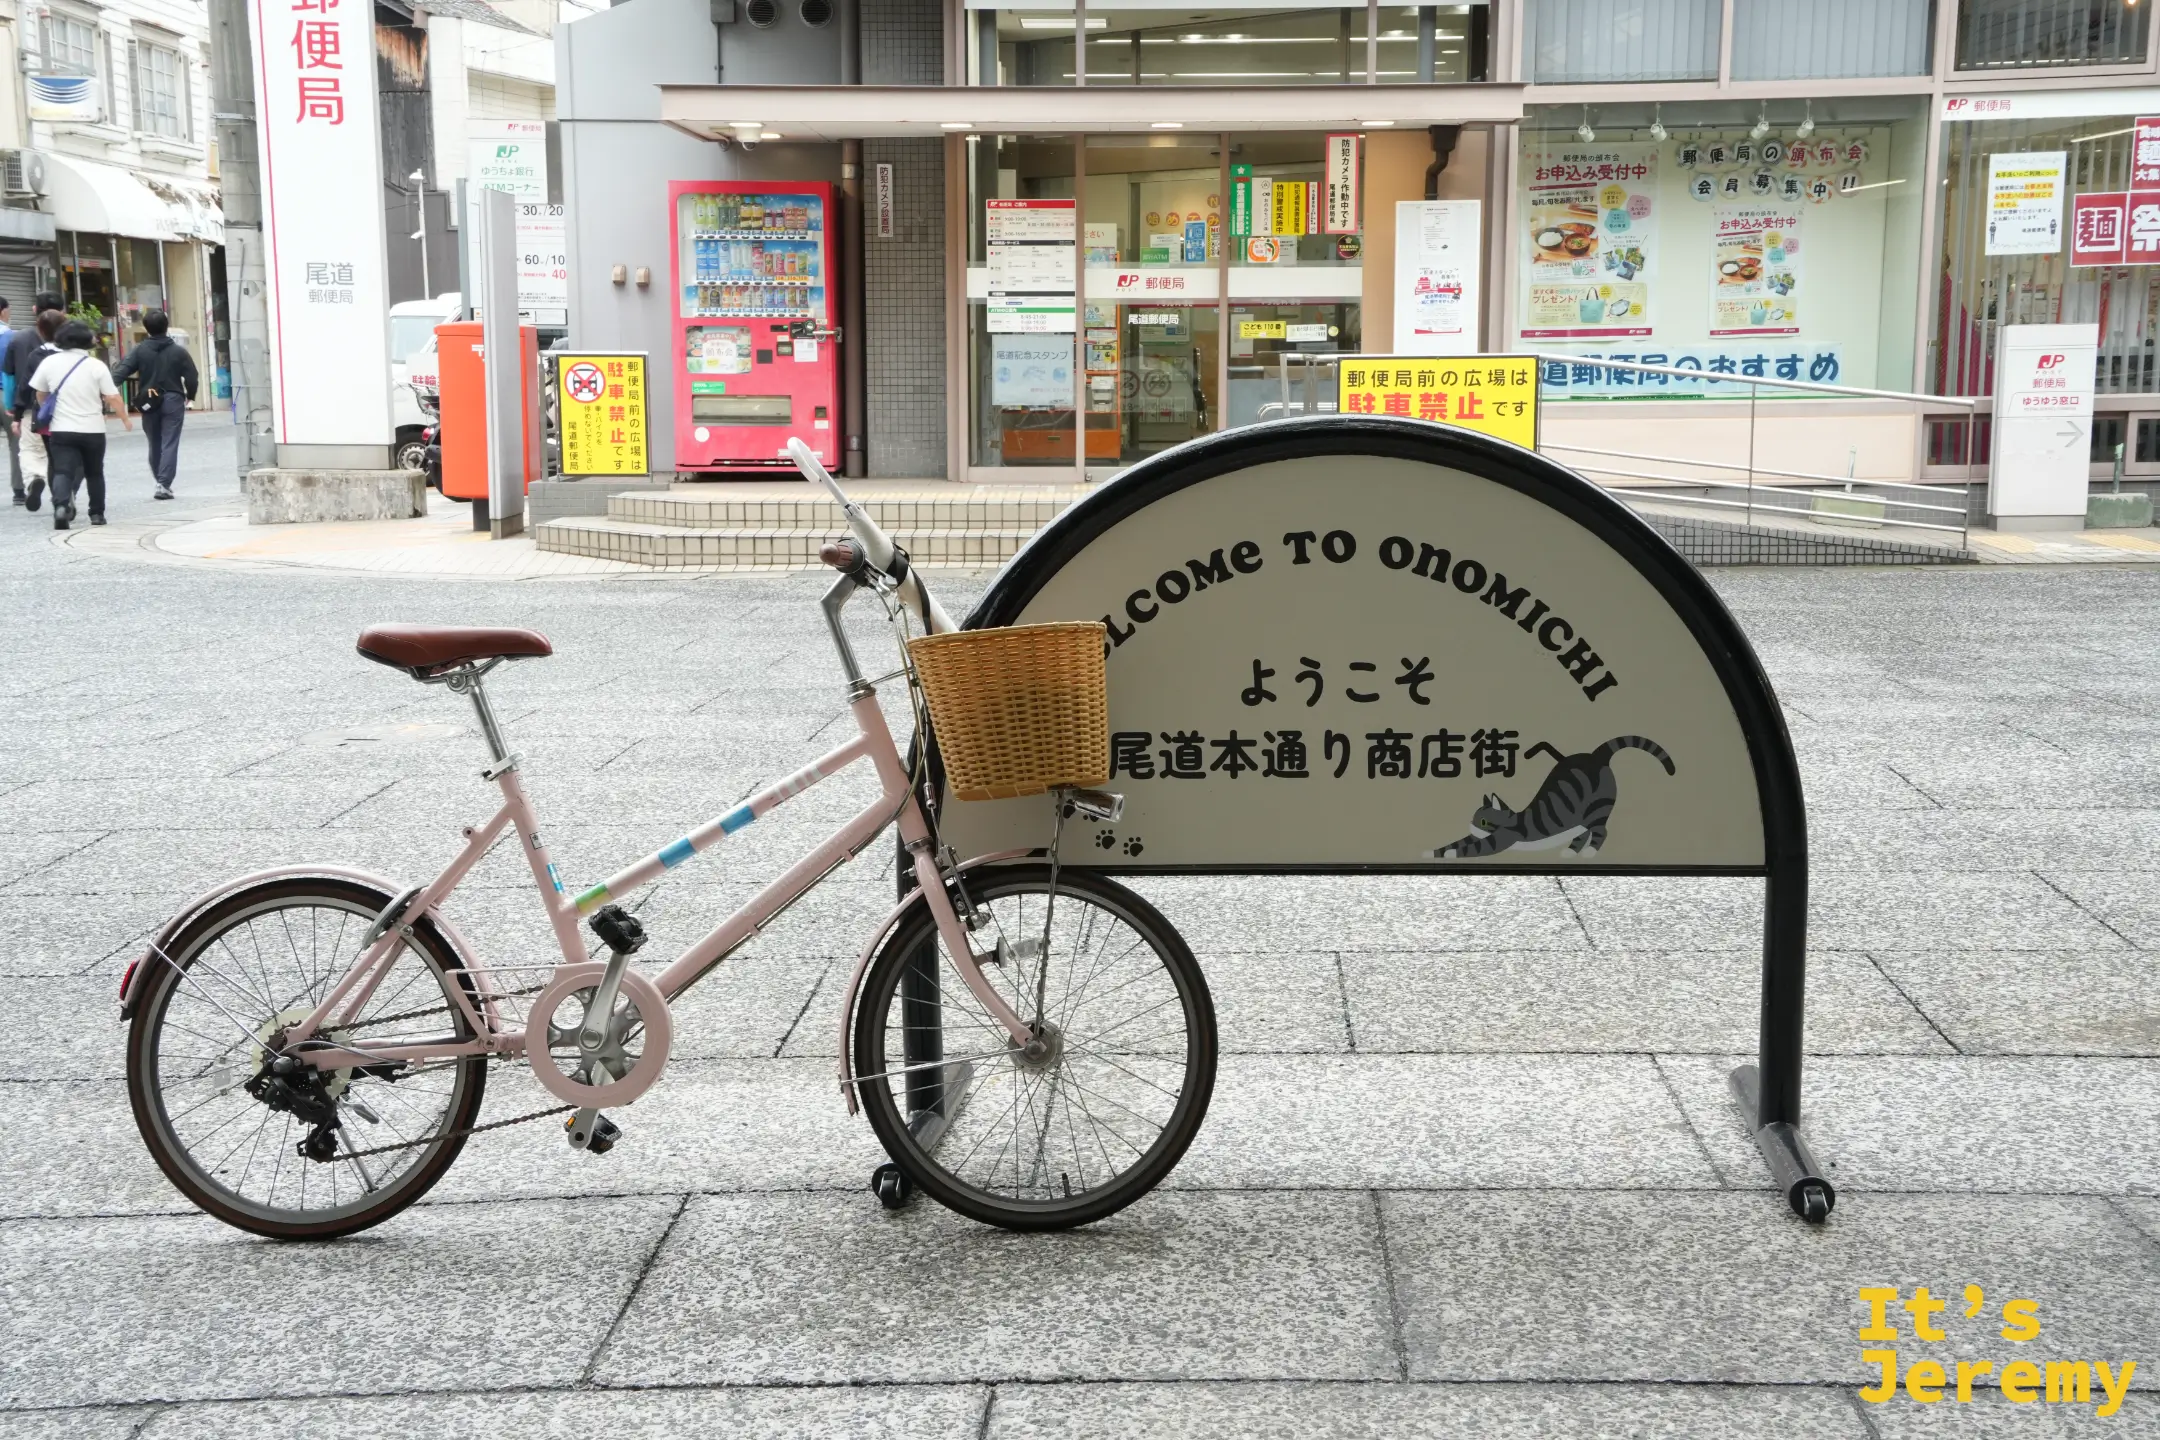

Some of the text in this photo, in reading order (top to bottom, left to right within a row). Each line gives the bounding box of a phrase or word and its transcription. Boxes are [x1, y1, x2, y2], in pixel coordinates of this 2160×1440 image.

[291, 0, 344, 126] 便局
[1974, 99, 2011, 112] 郵便局
[1682, 144, 1862, 164] 郵便局の頒布会
[481, 166, 534, 176] ゆうちょ銀行
[1535, 163, 1647, 181] お申込み受付中
[1340, 138, 1351, 228] 防犯カメラ作動中です
[879, 166, 890, 235] 防犯カメラ設置局
[1720, 216, 1797, 230] お申込み受付中
[305, 261, 355, 286] 尾道
[551, 269, 567, 280] 40
[1145, 277, 1185, 290] 郵便局
[308, 289, 354, 305] 郵便局
[1128, 313, 1180, 325] 尾道郵便局
[996, 350, 1068, 360] 尾道記念スタンプ
[411, 374, 439, 388] 駐輪
[1347, 369, 1529, 388] 郵便局前の広場は
[2032, 378, 2066, 388] 郵便局
[2022, 395, 2080, 406] ゆうゆう窓口
[607, 362, 627, 470] 駐車禁止です
[627, 361, 642, 470] 郵便局前の広場は
[568, 421, 579, 471] 尾道郵便局
[1103, 540, 1264, 660] LCOMe
[1282, 529, 1357, 565] TO
[1240, 656, 1435, 708] ようこそ
[1108, 727, 1565, 780] 尾道本通り商店街へ
